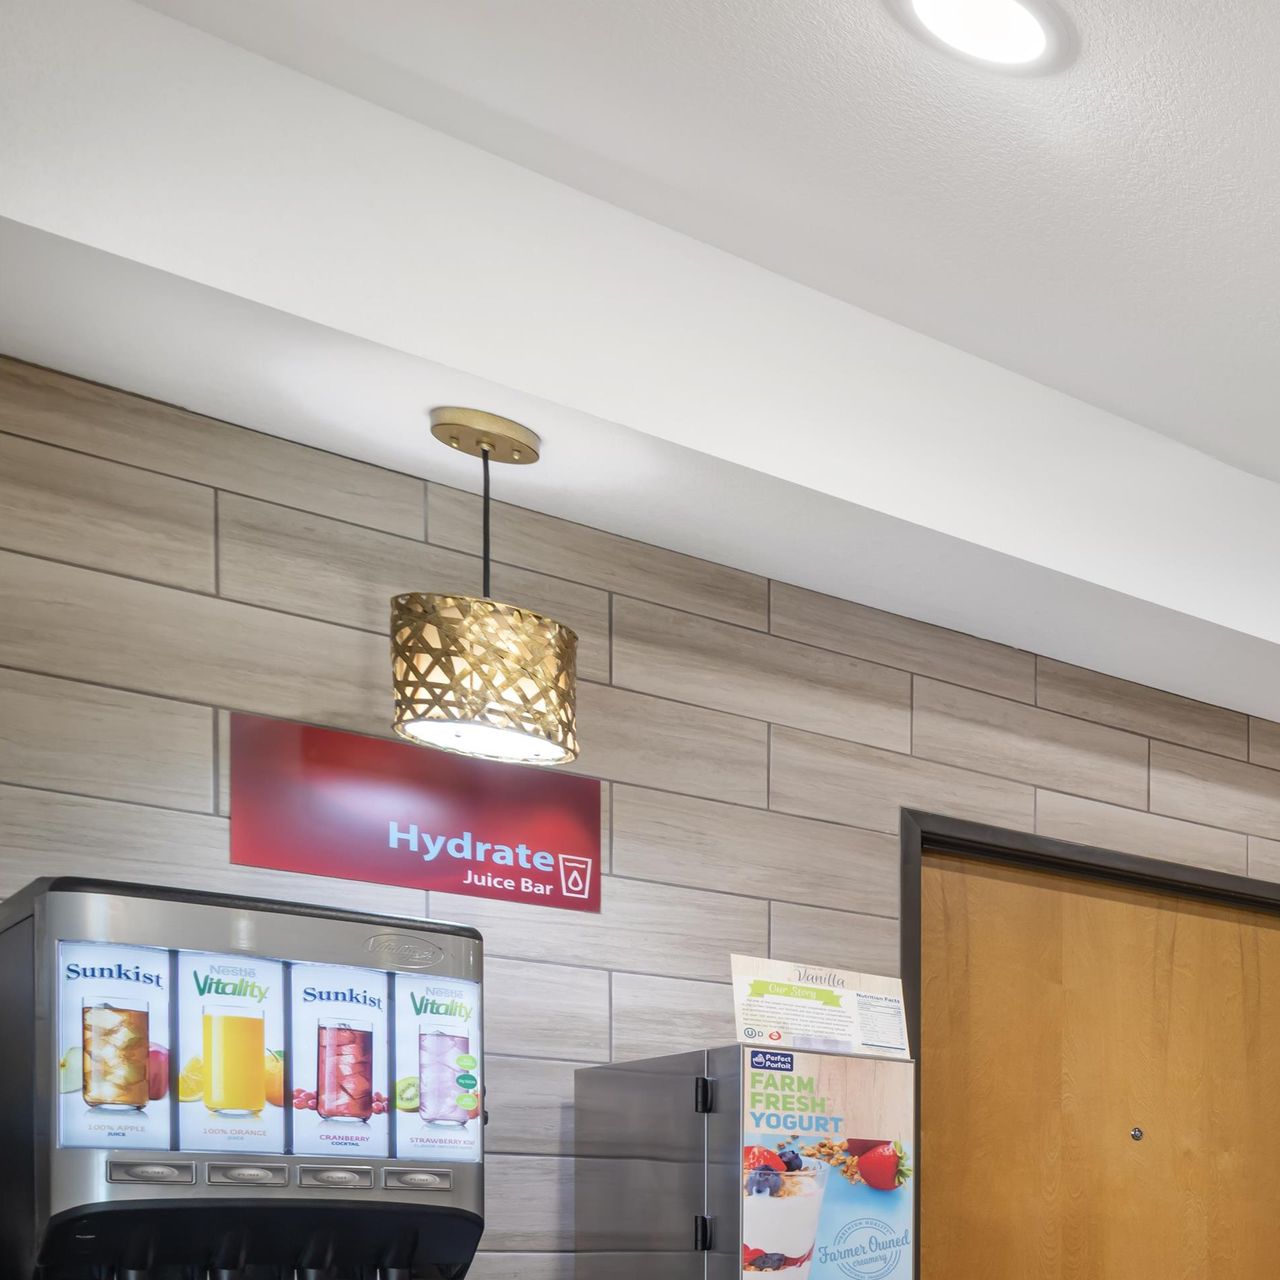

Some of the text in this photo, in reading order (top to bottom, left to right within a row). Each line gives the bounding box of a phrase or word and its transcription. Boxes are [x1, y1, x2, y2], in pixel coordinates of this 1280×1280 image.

[388, 820, 555, 872] Hydrate
[463, 870, 553, 895] Juice Bar
[66, 963, 164, 990] Sunkist
[193, 970, 269, 1003] Vitality
[795, 969, 846, 989] Vanilla
[303, 987, 384, 1013] Sunkist
[768, 984, 788, 995] Our
[410, 991, 472, 1022] Vitality
[765, 1054, 792, 1062] Perfect
[765, 1062, 792, 1070] Parfait
[751, 1072, 815, 1093] FARM
[751, 1092, 827, 1113] FRESH
[750, 1111, 843, 1133] YOGURT
[319, 1134, 370, 1142] CRANBERRY
[409, 1137, 462, 1146] STRAWBERRY
[818, 1228, 911, 1264] Farmer Owned
